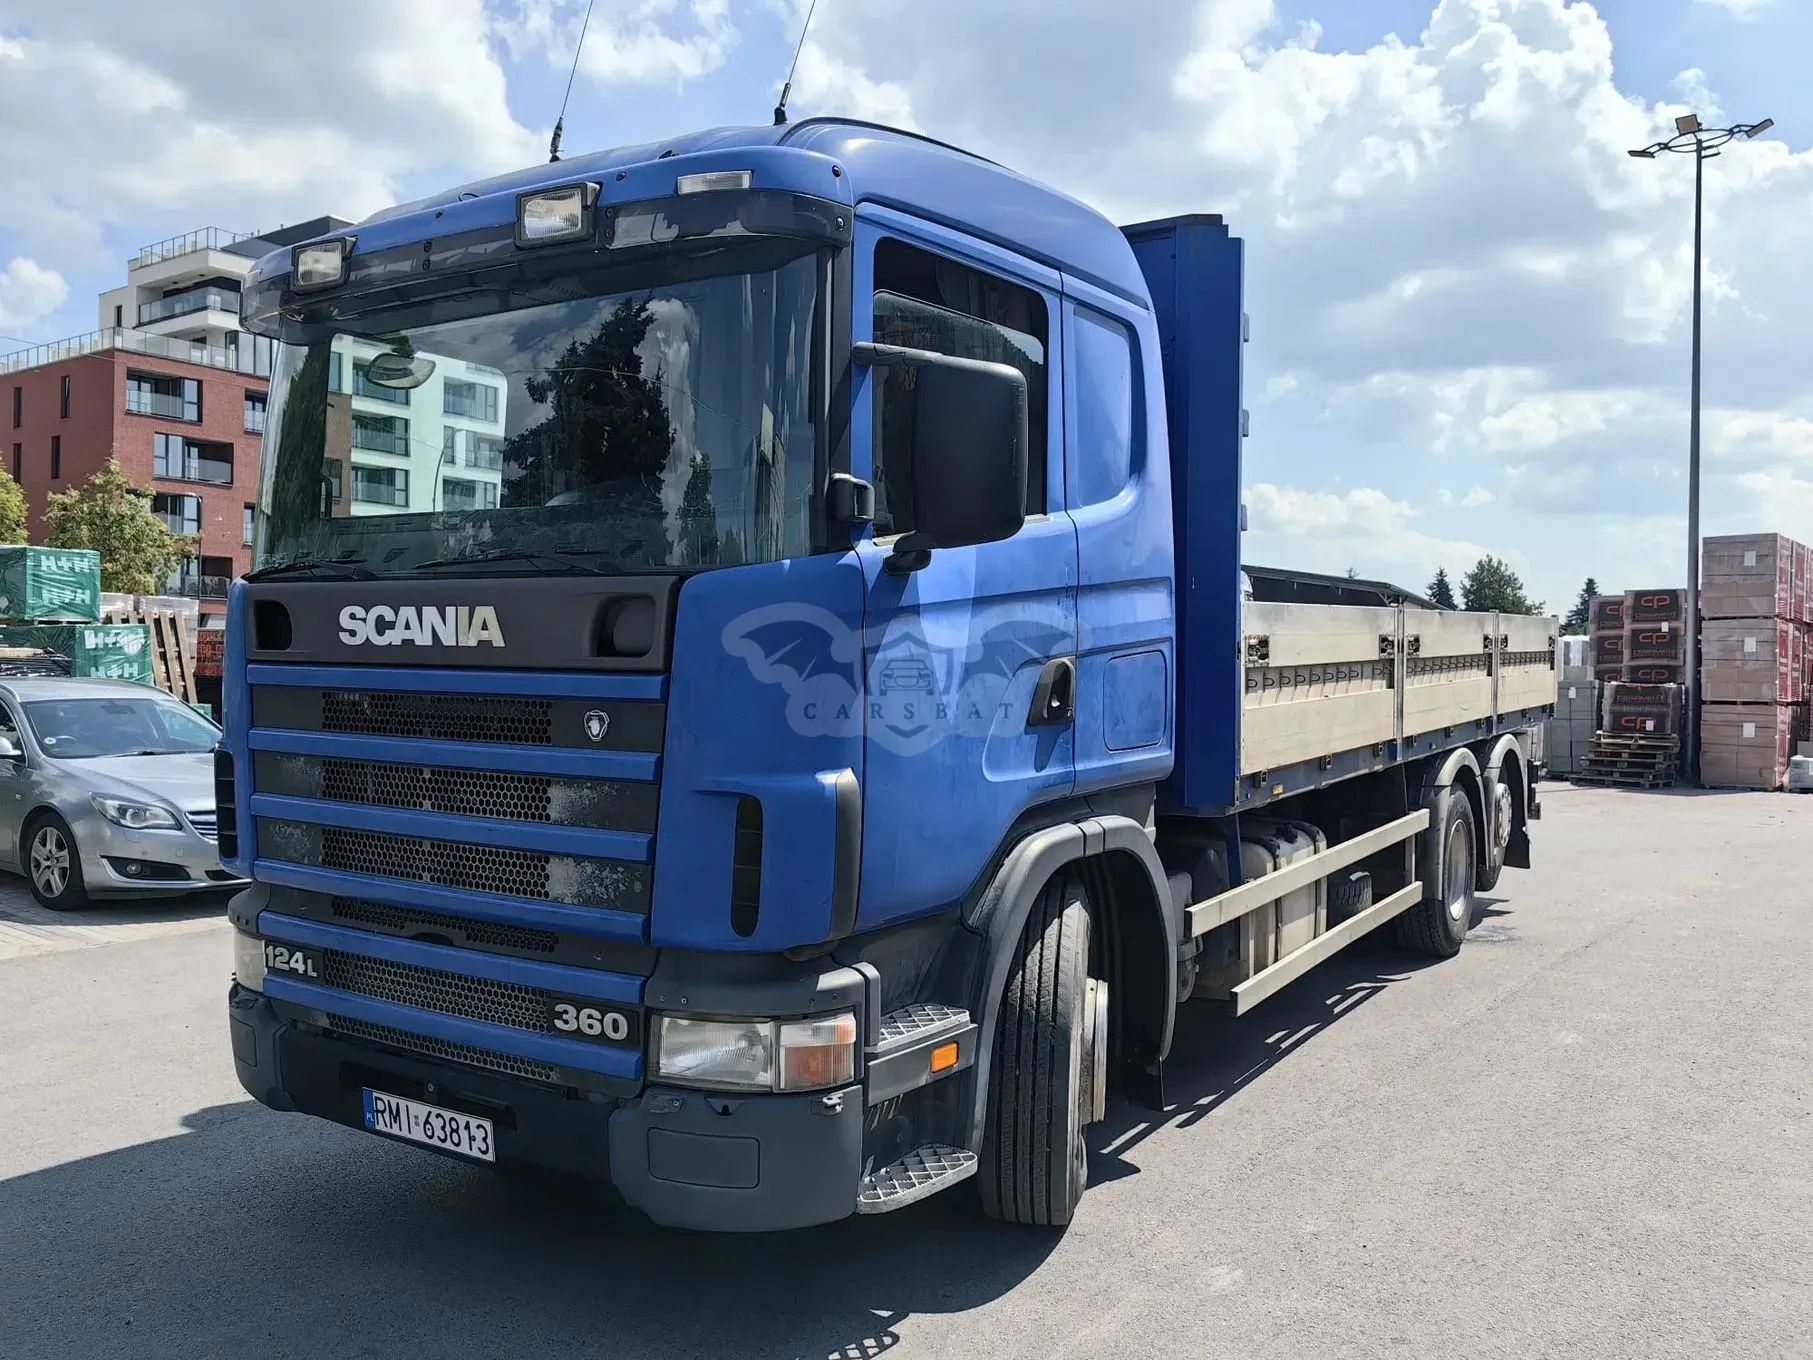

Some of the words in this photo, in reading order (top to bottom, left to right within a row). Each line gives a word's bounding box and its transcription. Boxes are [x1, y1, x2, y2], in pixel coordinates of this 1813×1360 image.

[338, 605, 506, 647] SCANIA
[554, 1003, 628, 1041] 360
[374, 1096, 412, 1135] RMI
[423, 1110, 490, 1156] 63813
